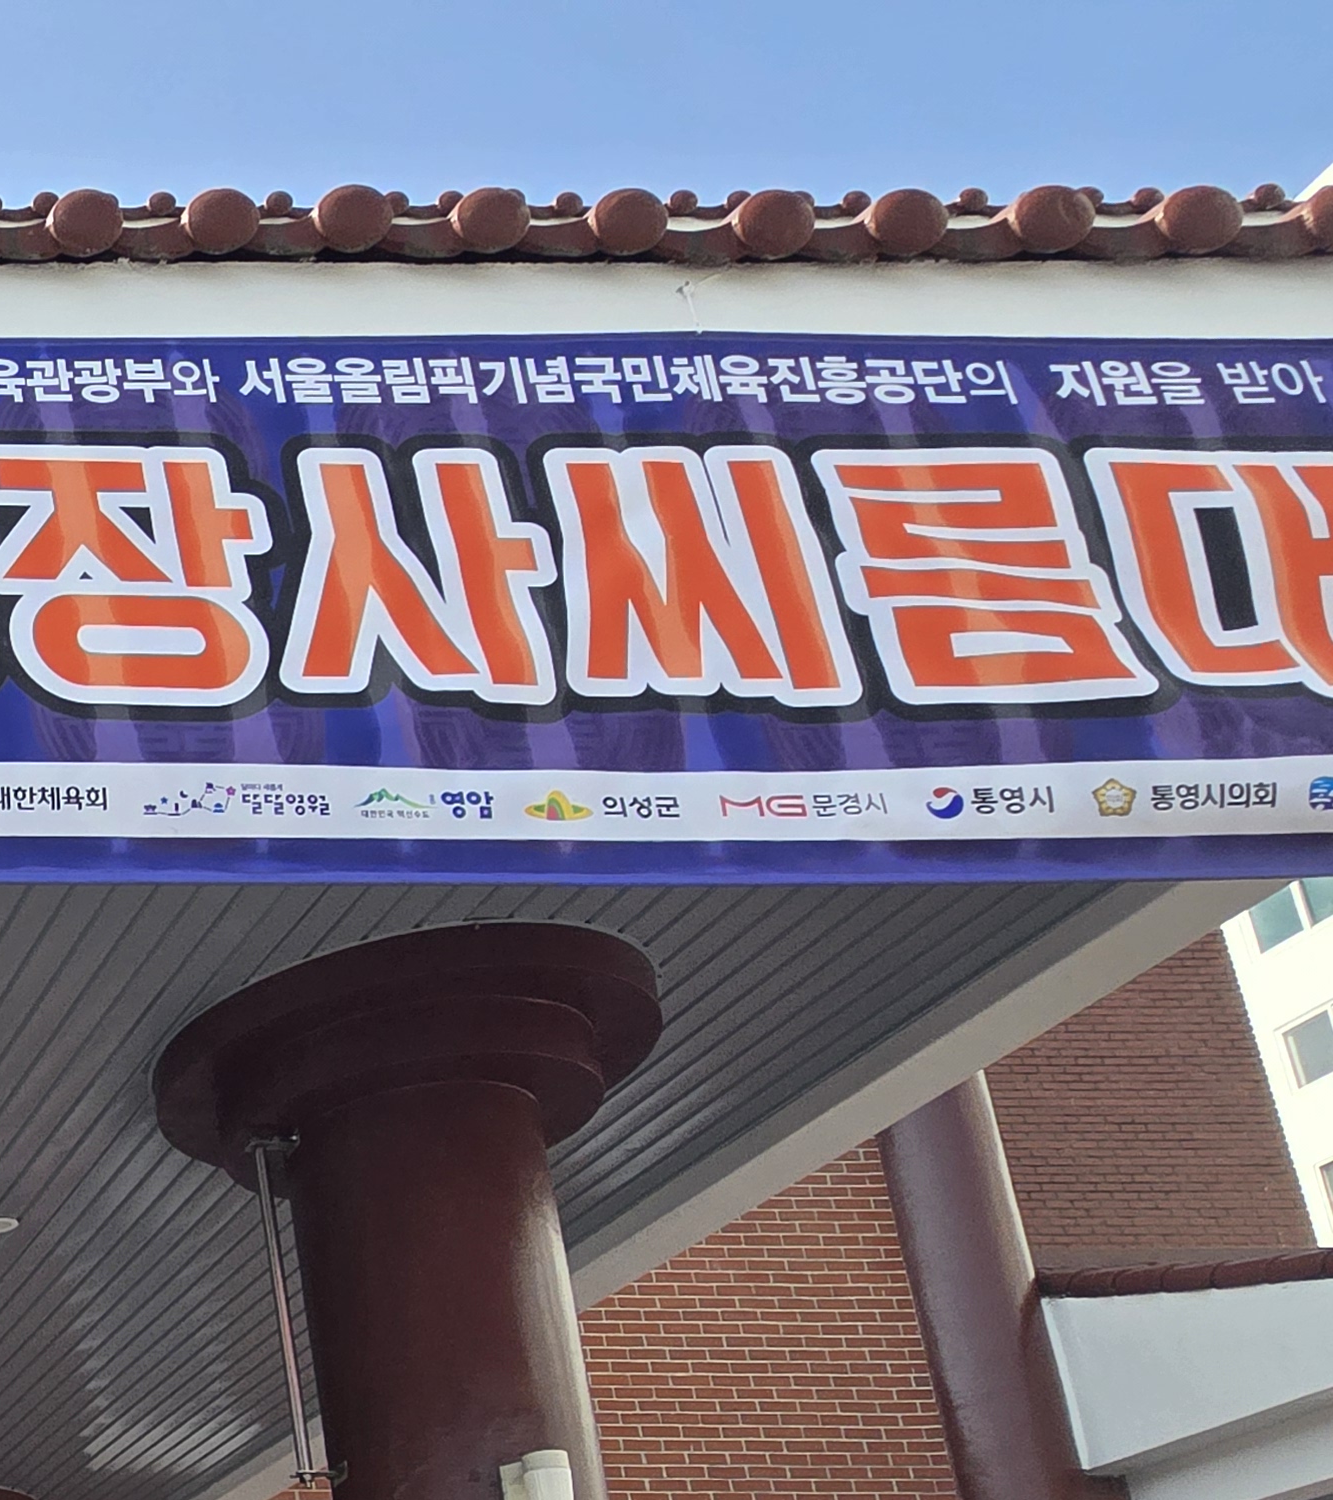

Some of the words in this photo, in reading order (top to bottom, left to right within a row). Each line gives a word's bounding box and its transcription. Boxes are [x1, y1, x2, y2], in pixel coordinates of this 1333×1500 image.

[239, 355, 1018, 405] 서울올림픽기념국민체육진흥공단의
[1049, 361, 1205, 406] 지원을
[1216, 360, 1327, 404] 받아
[441, 791, 494, 819] 영암
[602, 796, 680, 819] 의성군
[971, 785, 1056, 815] 통영시
[1150, 782, 1278, 811] 통영시의회
